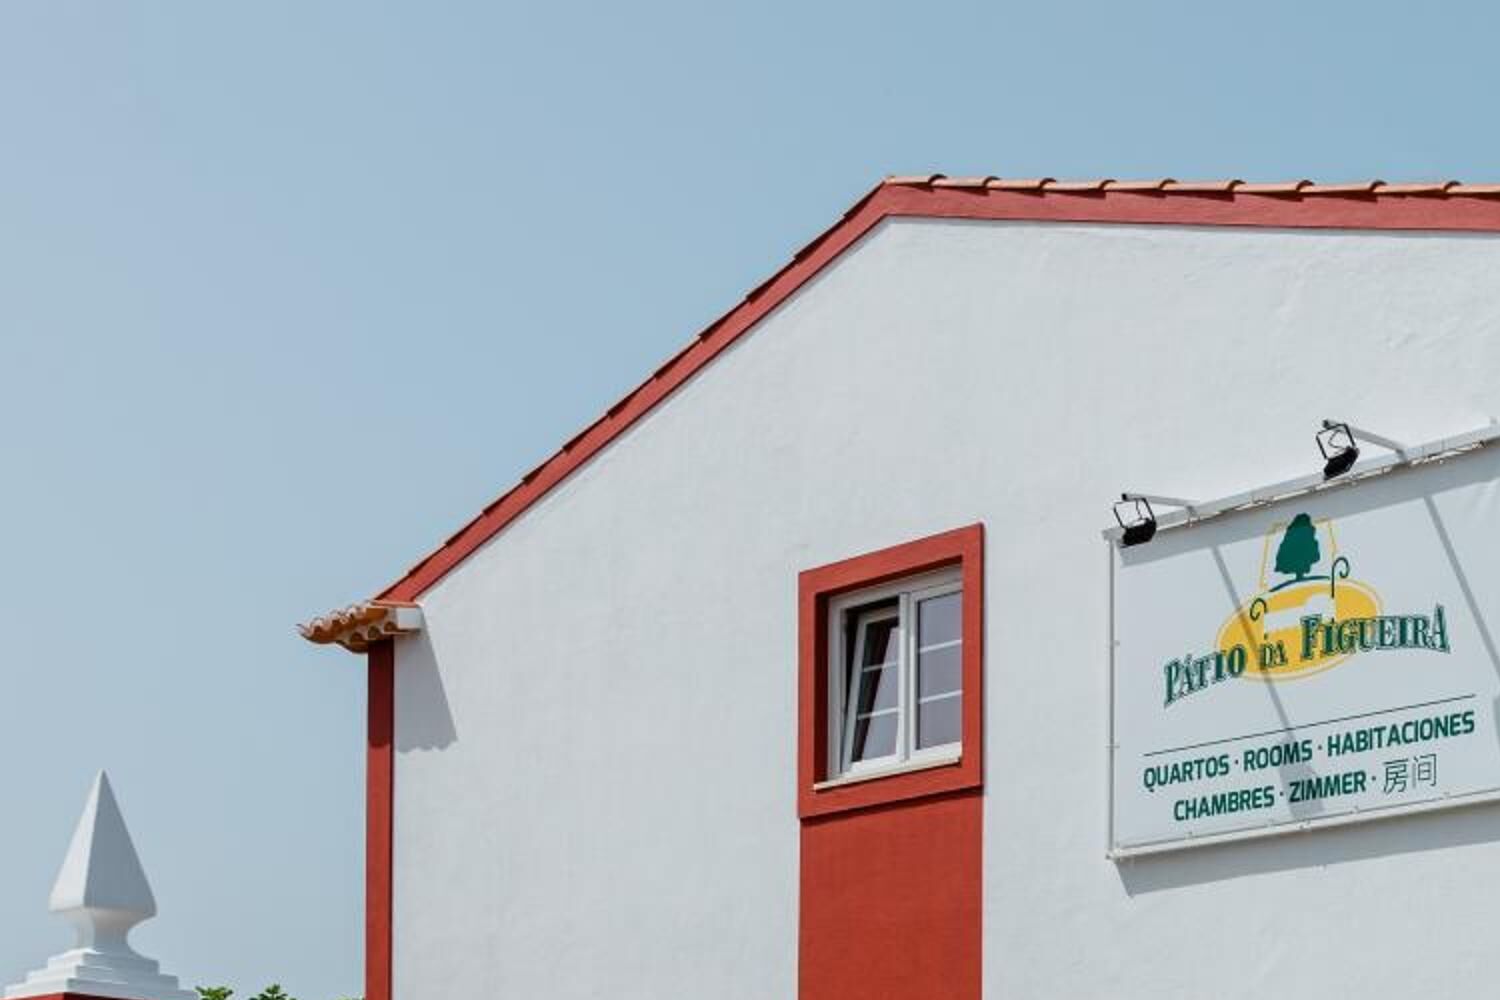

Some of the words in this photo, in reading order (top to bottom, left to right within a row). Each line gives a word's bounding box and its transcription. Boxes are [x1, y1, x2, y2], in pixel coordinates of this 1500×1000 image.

[1164, 644, 1248, 709] PÁTIO
[1260, 640, 1288, 670] DA
[1300, 602, 1451, 659] FIGUEIRA
[1143, 754, 1230, 792] QUARTOS
[1243, 740, 1313, 772] ROOMS
[1327, 710, 1476, 757] HABITACIONES
[1173, 785, 1275, 822] CHAMBRES
[1289, 770, 1366, 803] ZIMMER
[1382, 753, 1437, 796] 房间
